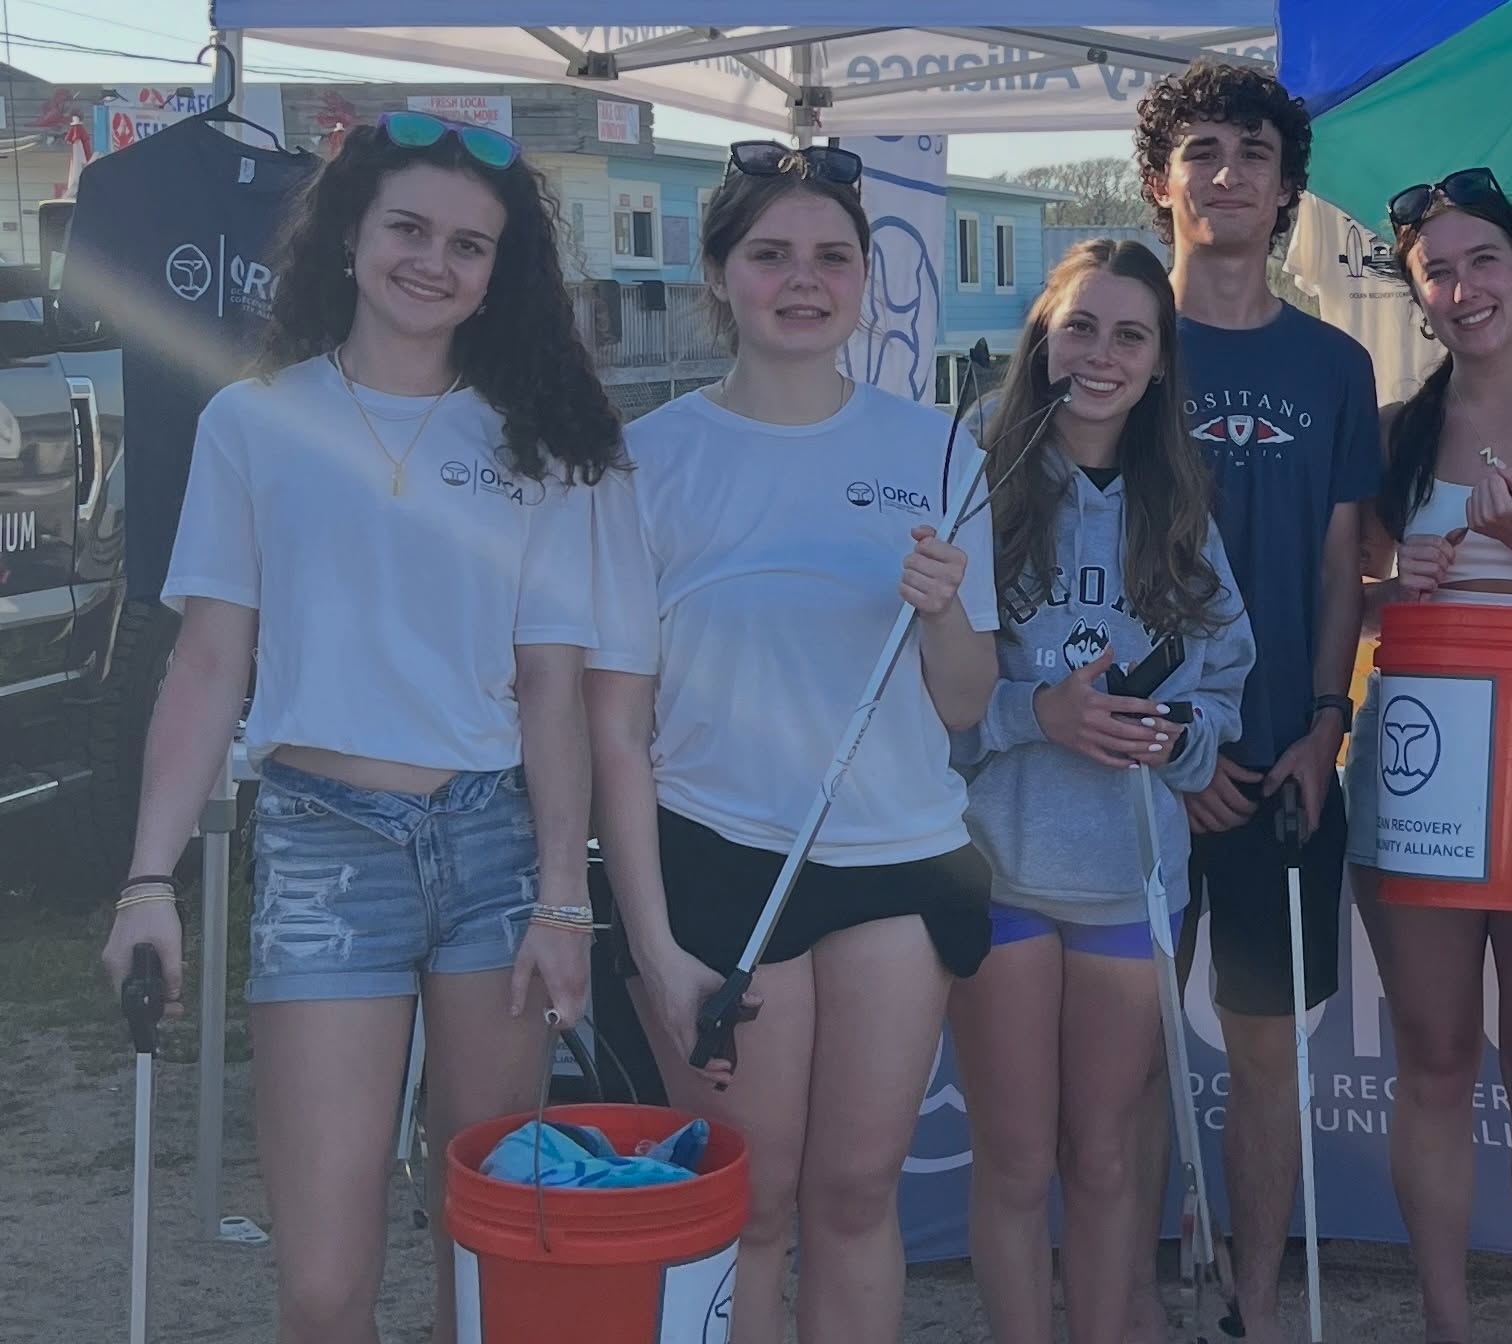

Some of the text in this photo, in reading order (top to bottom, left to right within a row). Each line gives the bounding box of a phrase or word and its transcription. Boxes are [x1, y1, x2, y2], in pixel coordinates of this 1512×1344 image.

[1183, 390, 1312, 428] OSITANO
[882, 486, 931, 512] ORCA
[0, 511, 36, 552] UM
[1035, 646, 1057, 669] 18
[1391, 818, 1463, 835] RECOVERY
[1403, 842, 1476, 859] ALLIANCE
